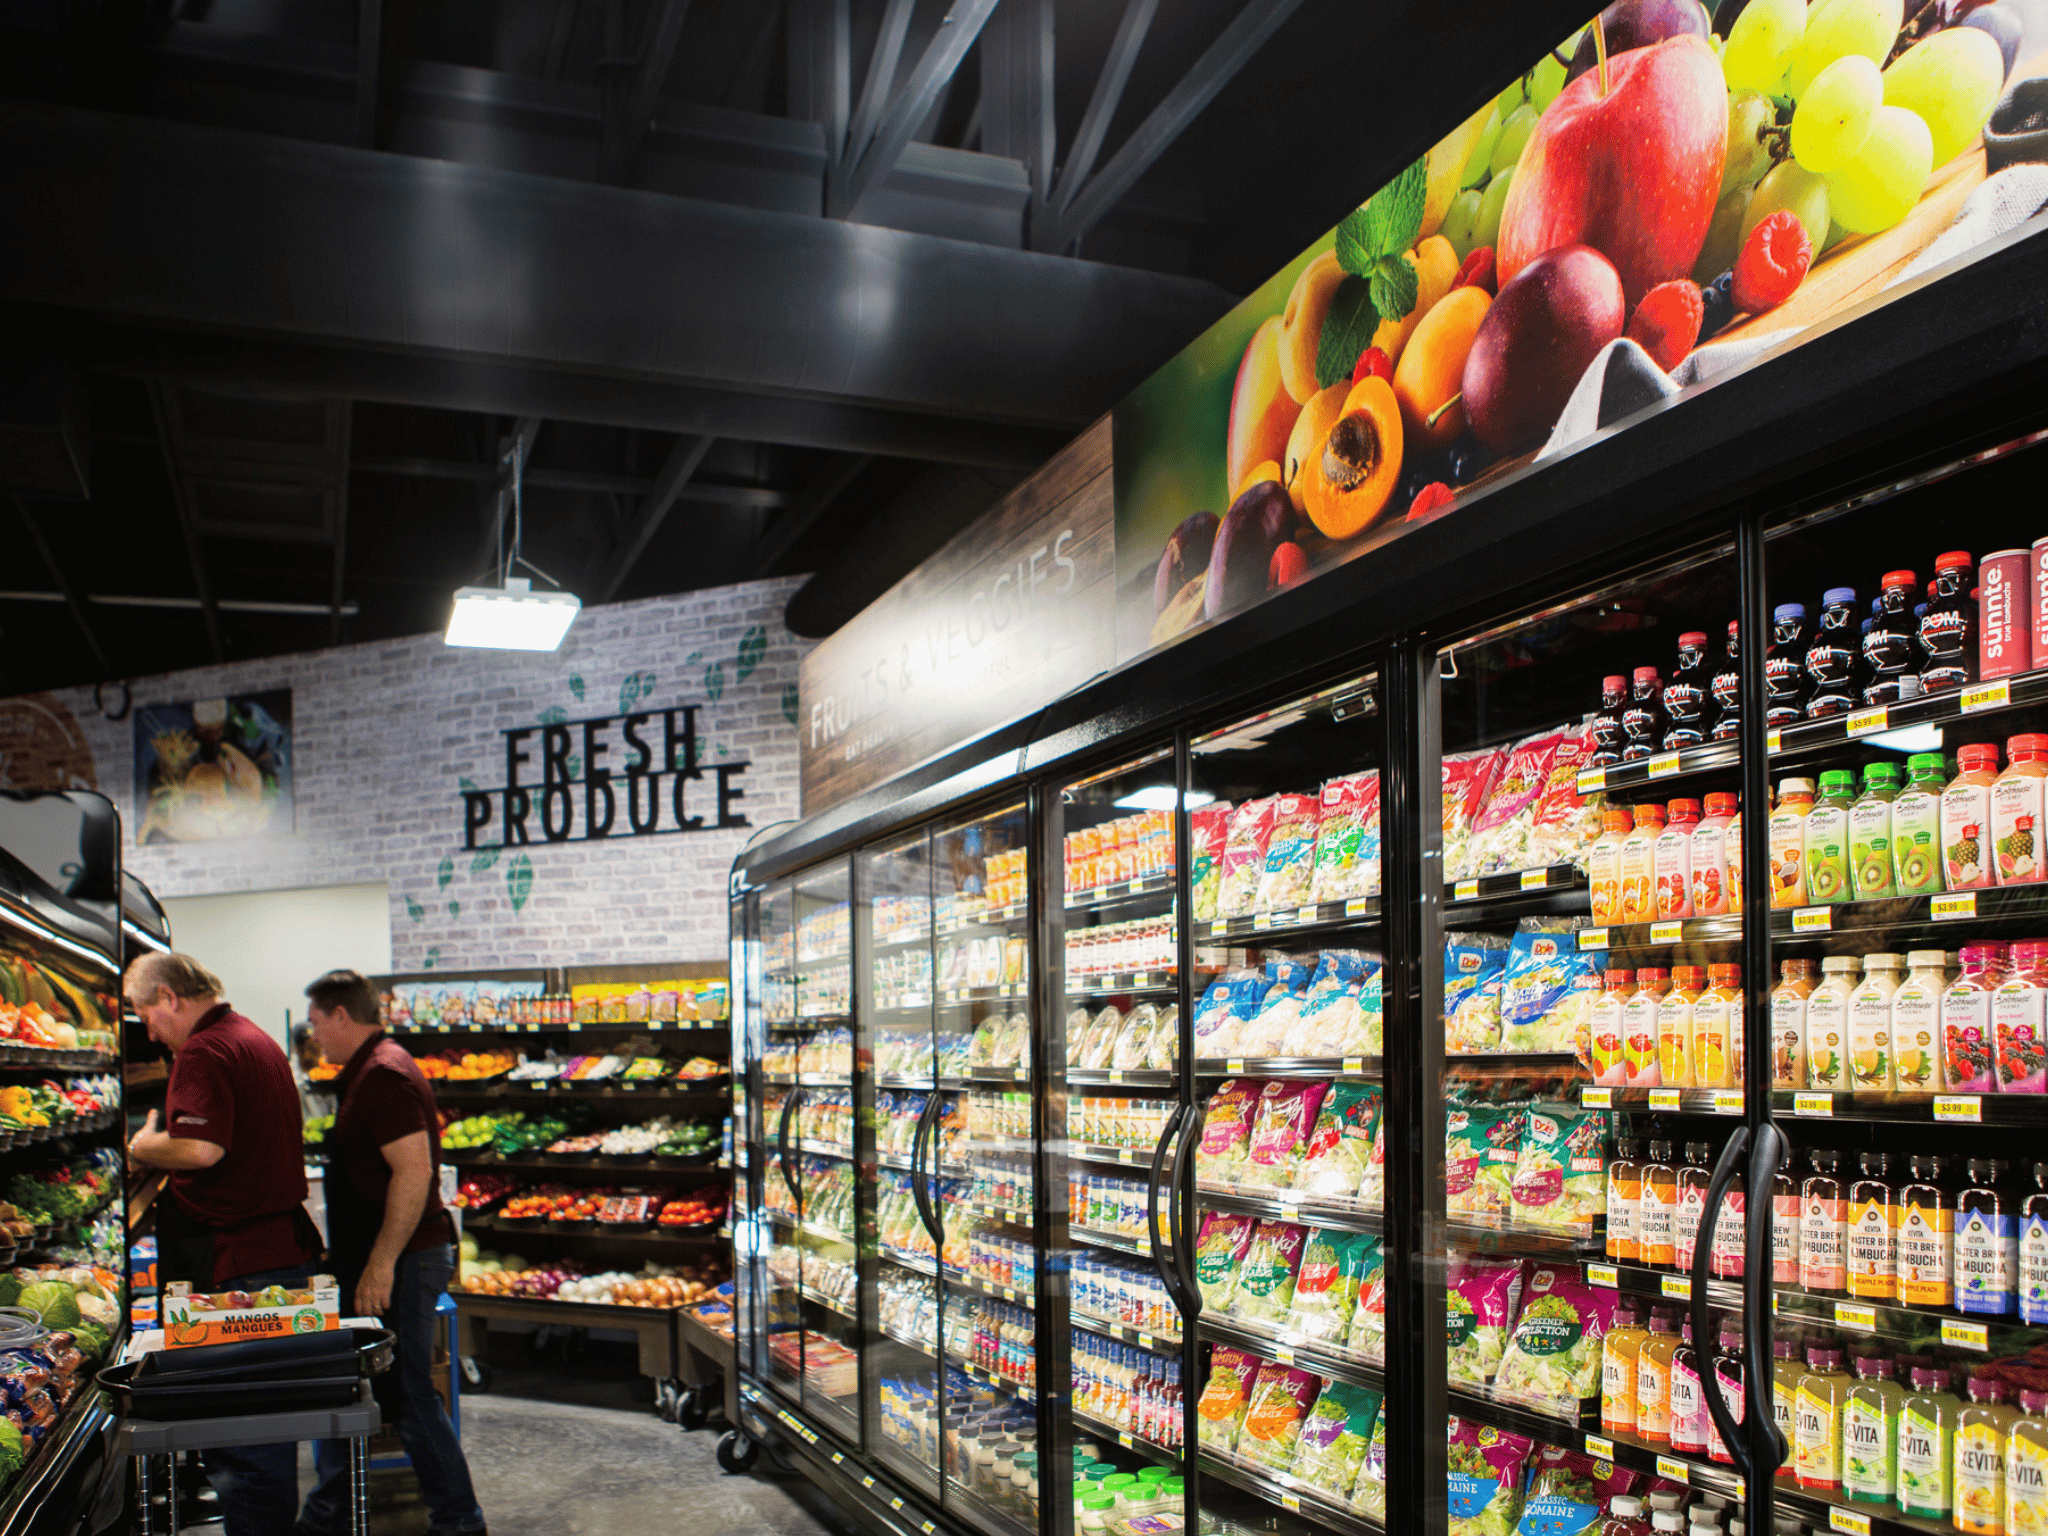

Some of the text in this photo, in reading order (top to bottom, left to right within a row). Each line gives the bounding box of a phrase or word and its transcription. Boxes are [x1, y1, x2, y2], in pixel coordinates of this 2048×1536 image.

[1922, 610, 1959, 629] POM
[811, 658, 889, 749] FRUITS
[899, 642, 913, 693] &
[925, 530, 1076, 672] VEGGIES
[1969, 692, 1989, 703] $3.19
[503, 706, 700, 789] FRESH
[463, 762, 750, 850] PRODUCE
[1936, 902, 1957, 912] $3.99
[1798, 915, 1816, 925] $3.99
[1799, 1100, 1817, 1109] $3.99
[1941, 1103, 1962, 1113] $3.99
[1571, 1157, 1603, 1172] MARVEL
[1652, 1212, 1671, 1220] BREW
[1907, 1230, 1924, 1238] KEVITA
[225, 1312, 280, 1325] MANGOS
[221, 1322, 283, 1335] MANGUES
[1948, 1329, 1968, 1340] $4.49
